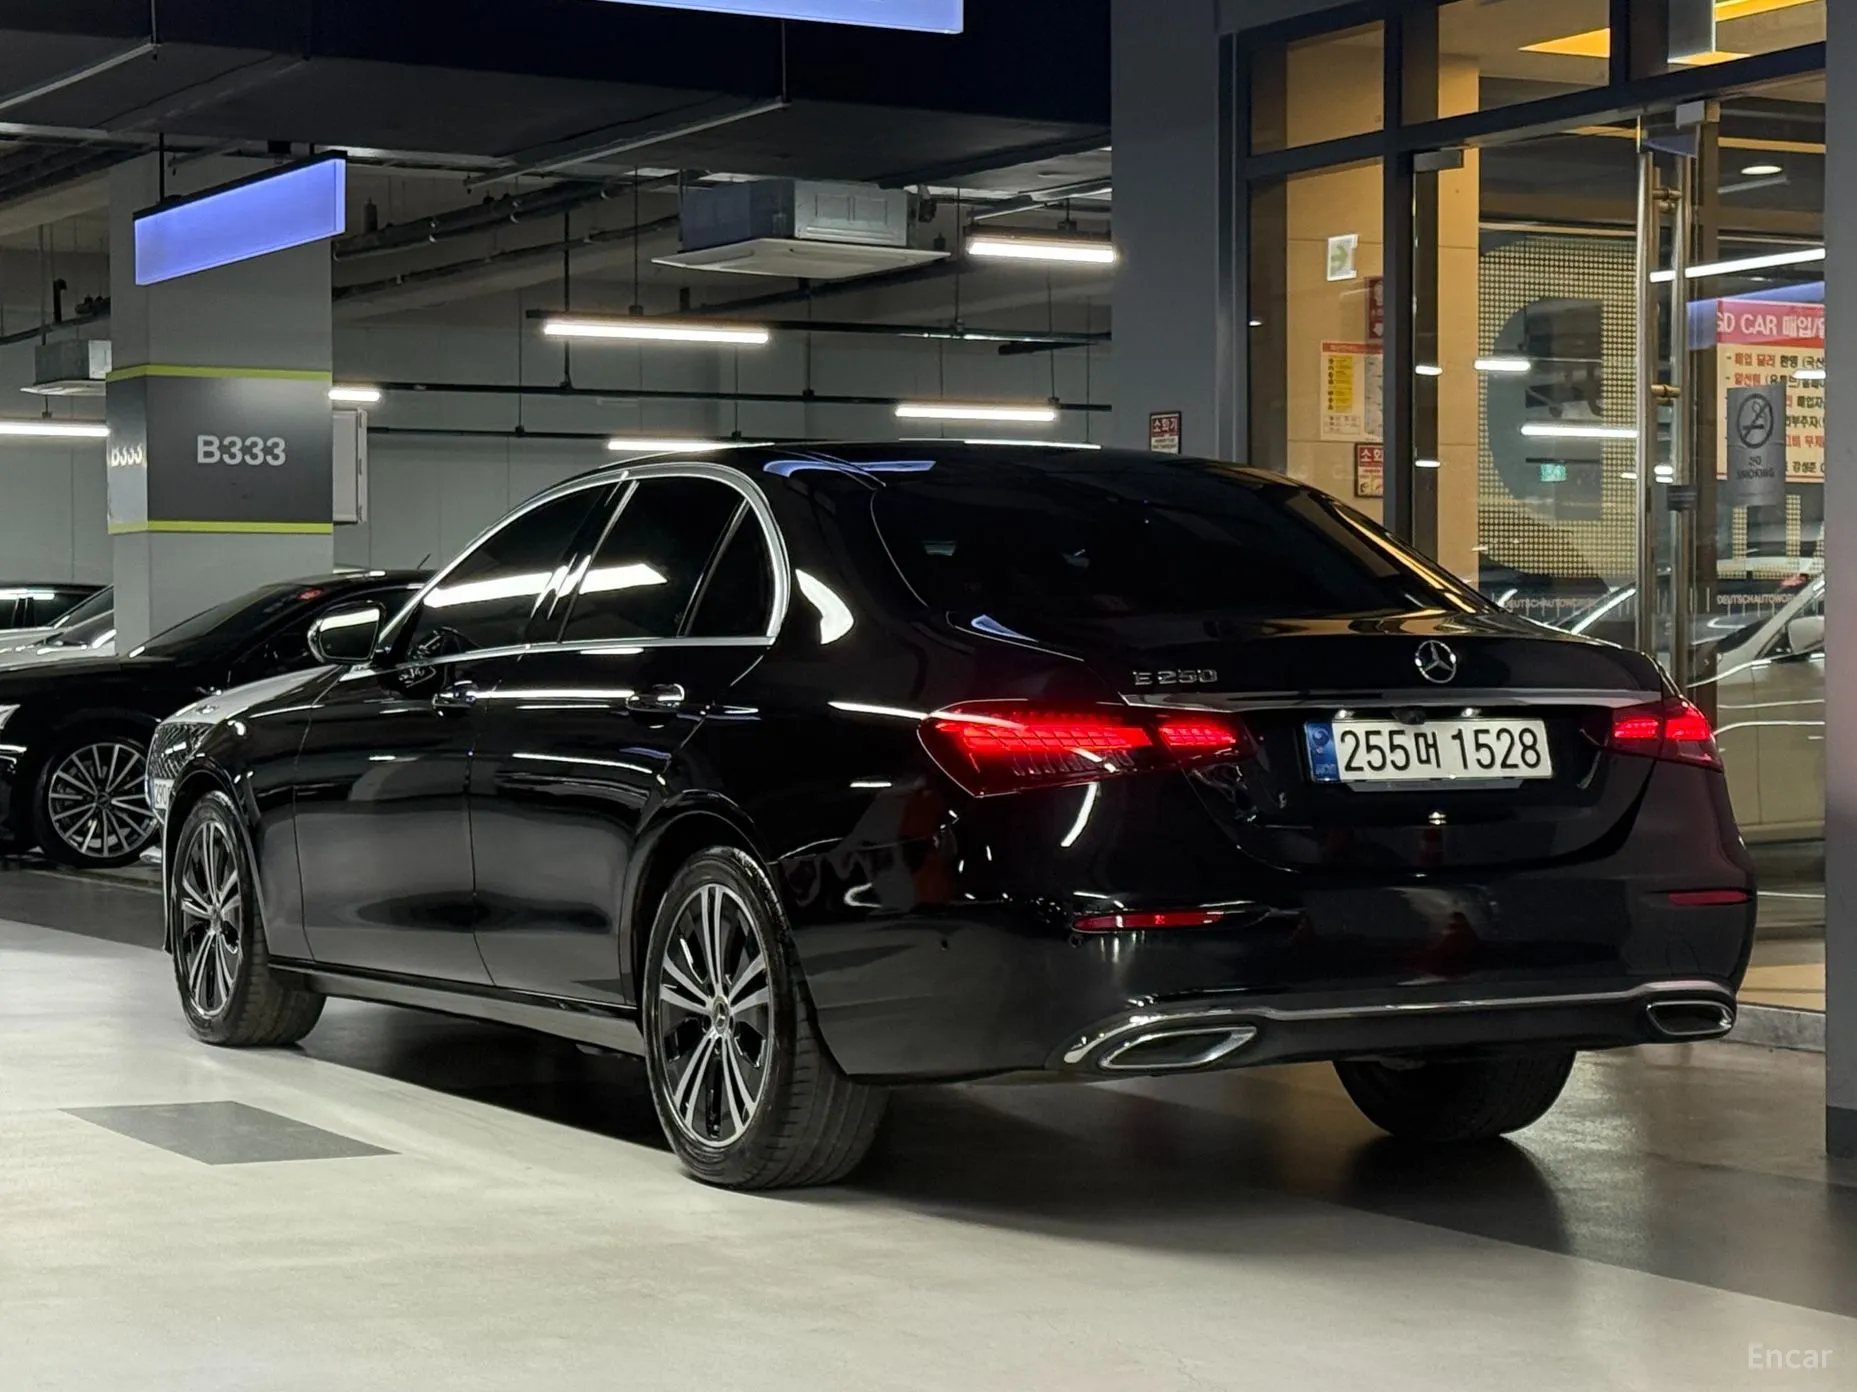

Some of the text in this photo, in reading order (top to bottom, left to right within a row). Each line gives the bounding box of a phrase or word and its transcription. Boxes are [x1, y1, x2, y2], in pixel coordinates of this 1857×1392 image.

[1741, 313, 1777, 336] CAR
[196, 434, 287, 467] B333
[1132, 669, 1218, 686] E 250
[1340, 728, 1542, 772] 255머 1528
